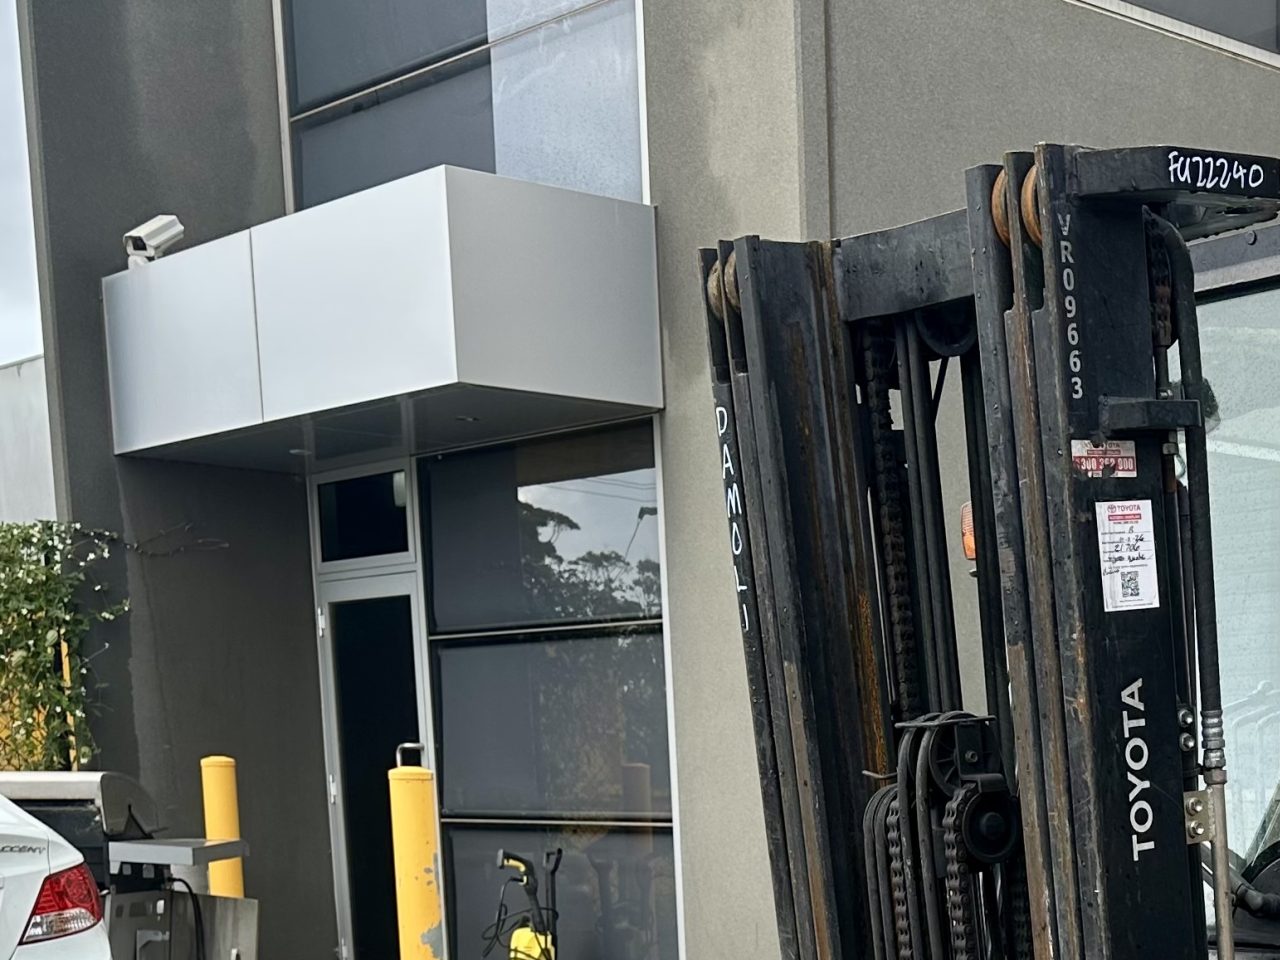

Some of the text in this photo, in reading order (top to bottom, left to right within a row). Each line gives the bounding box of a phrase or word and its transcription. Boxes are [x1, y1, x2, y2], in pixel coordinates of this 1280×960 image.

[1168, 150, 1264, 189] FU22240
[1120, 677, 1156, 862] TOYOTA
[0, 845, 46, 854] CCENT
